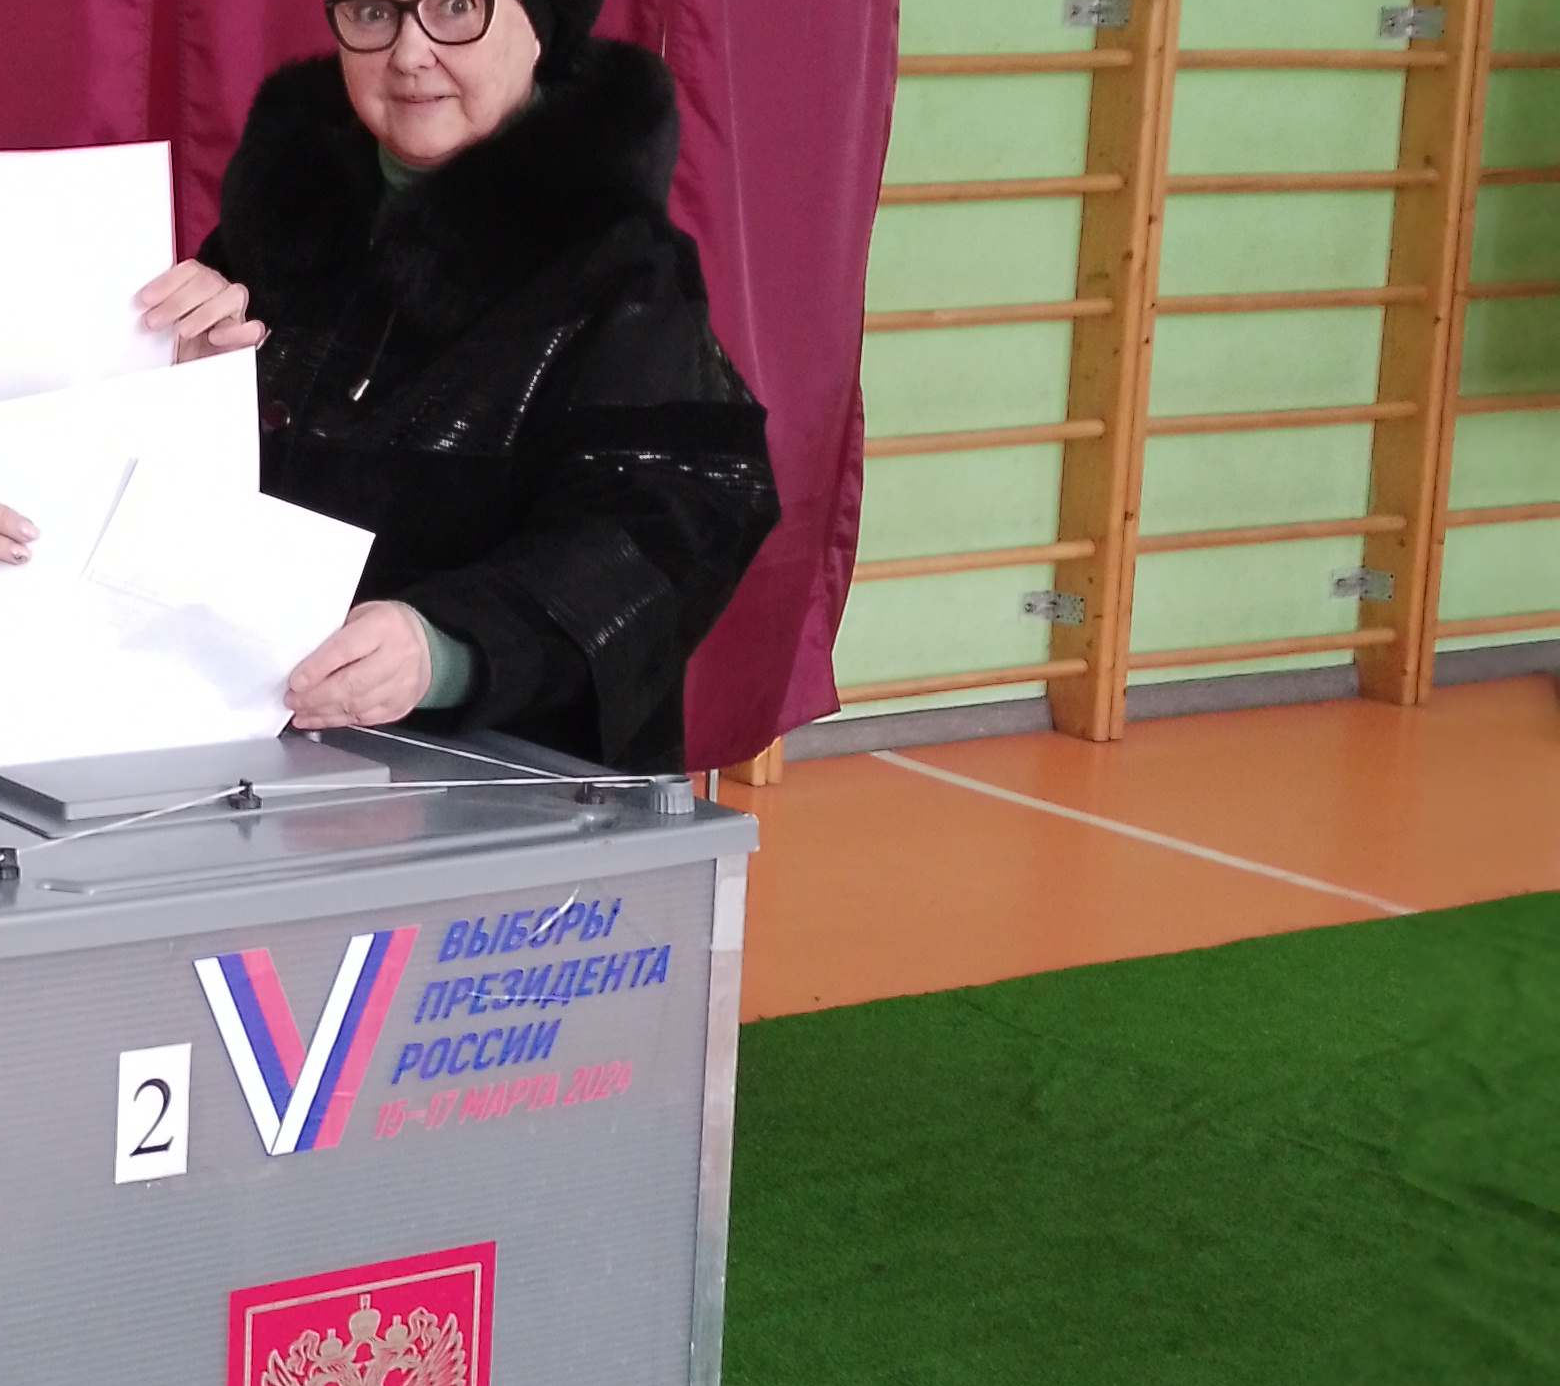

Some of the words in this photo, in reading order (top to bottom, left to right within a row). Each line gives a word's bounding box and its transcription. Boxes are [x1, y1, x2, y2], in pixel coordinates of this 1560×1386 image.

[438, 898, 621, 963] ВЫБОРЫ
[414, 945, 671, 1024] ПРЕЗИДЕНТА
[390, 1018, 562, 1085] РОССИИ
[129, 1078, 174, 1158] 2
[458, 1074, 559, 1124] МАРТА
[562, 1061, 632, 1105] 2024
